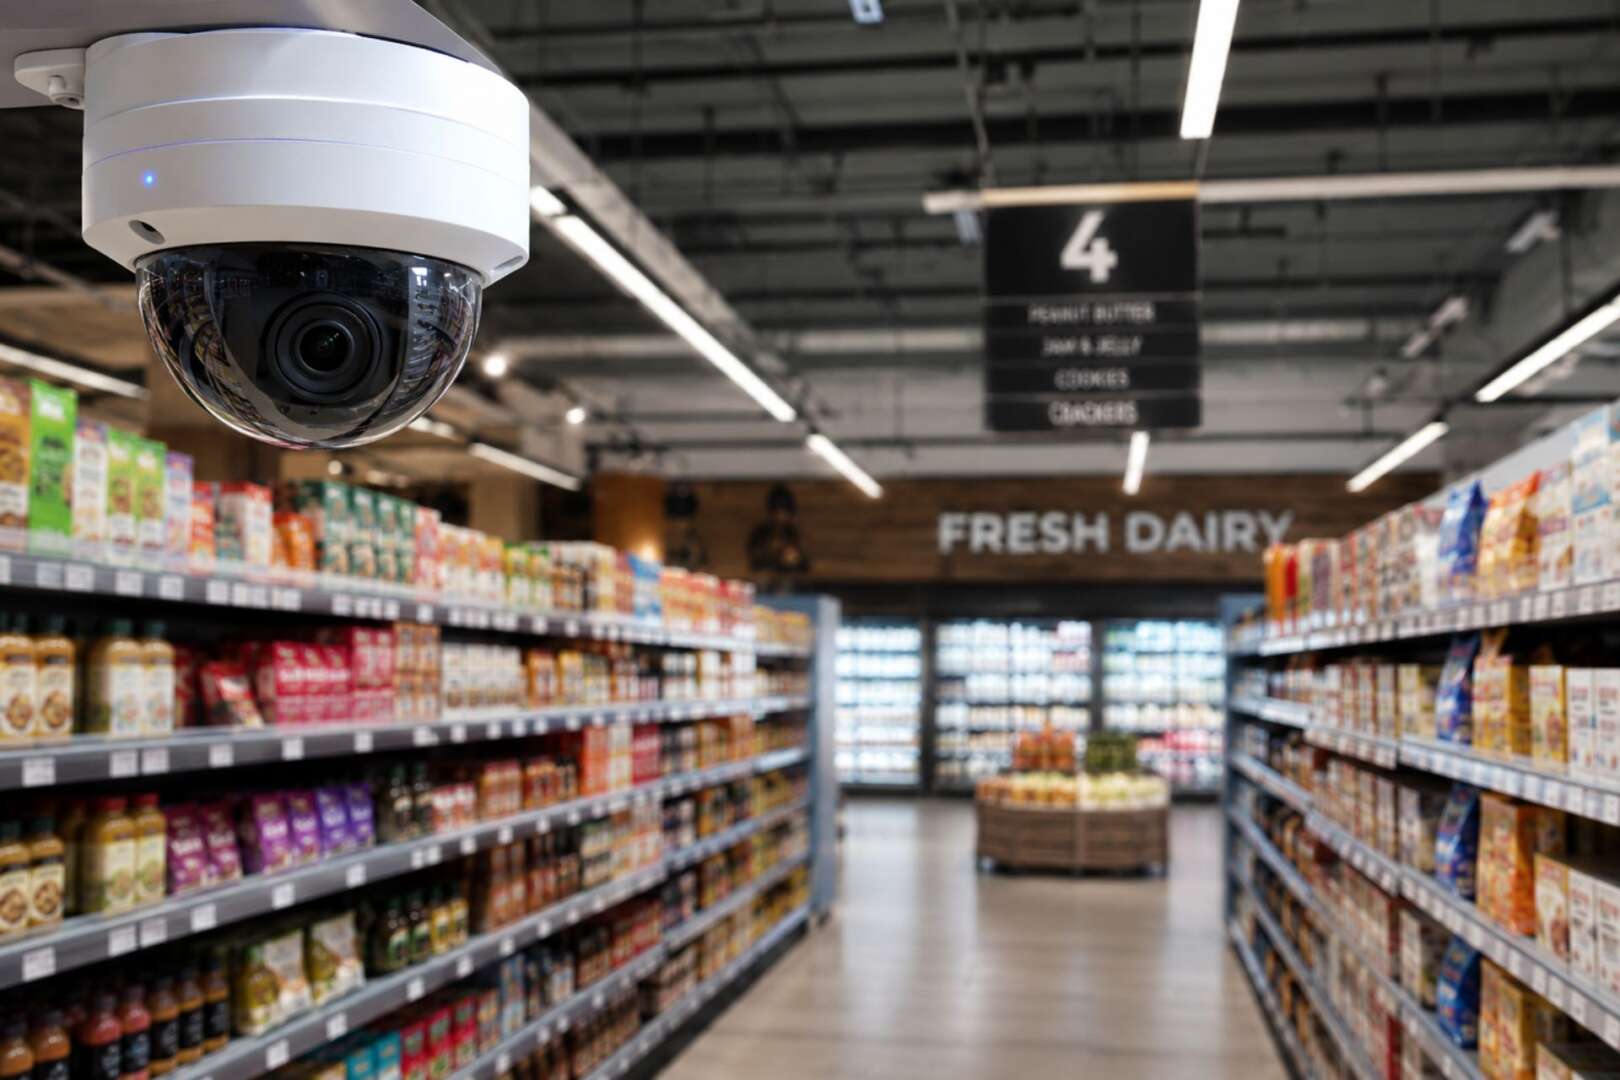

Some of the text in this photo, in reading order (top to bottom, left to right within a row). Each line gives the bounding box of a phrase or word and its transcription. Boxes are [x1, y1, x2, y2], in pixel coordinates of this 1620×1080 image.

[1059, 210, 1118, 282] 4
[1030, 304, 1153, 322] PEANUT BUTTER
[1055, 369, 1129, 388] COOKIES
[1049, 402, 1137, 425] CRACKERS
[938, 510, 1293, 553] FRESH DAIRY
